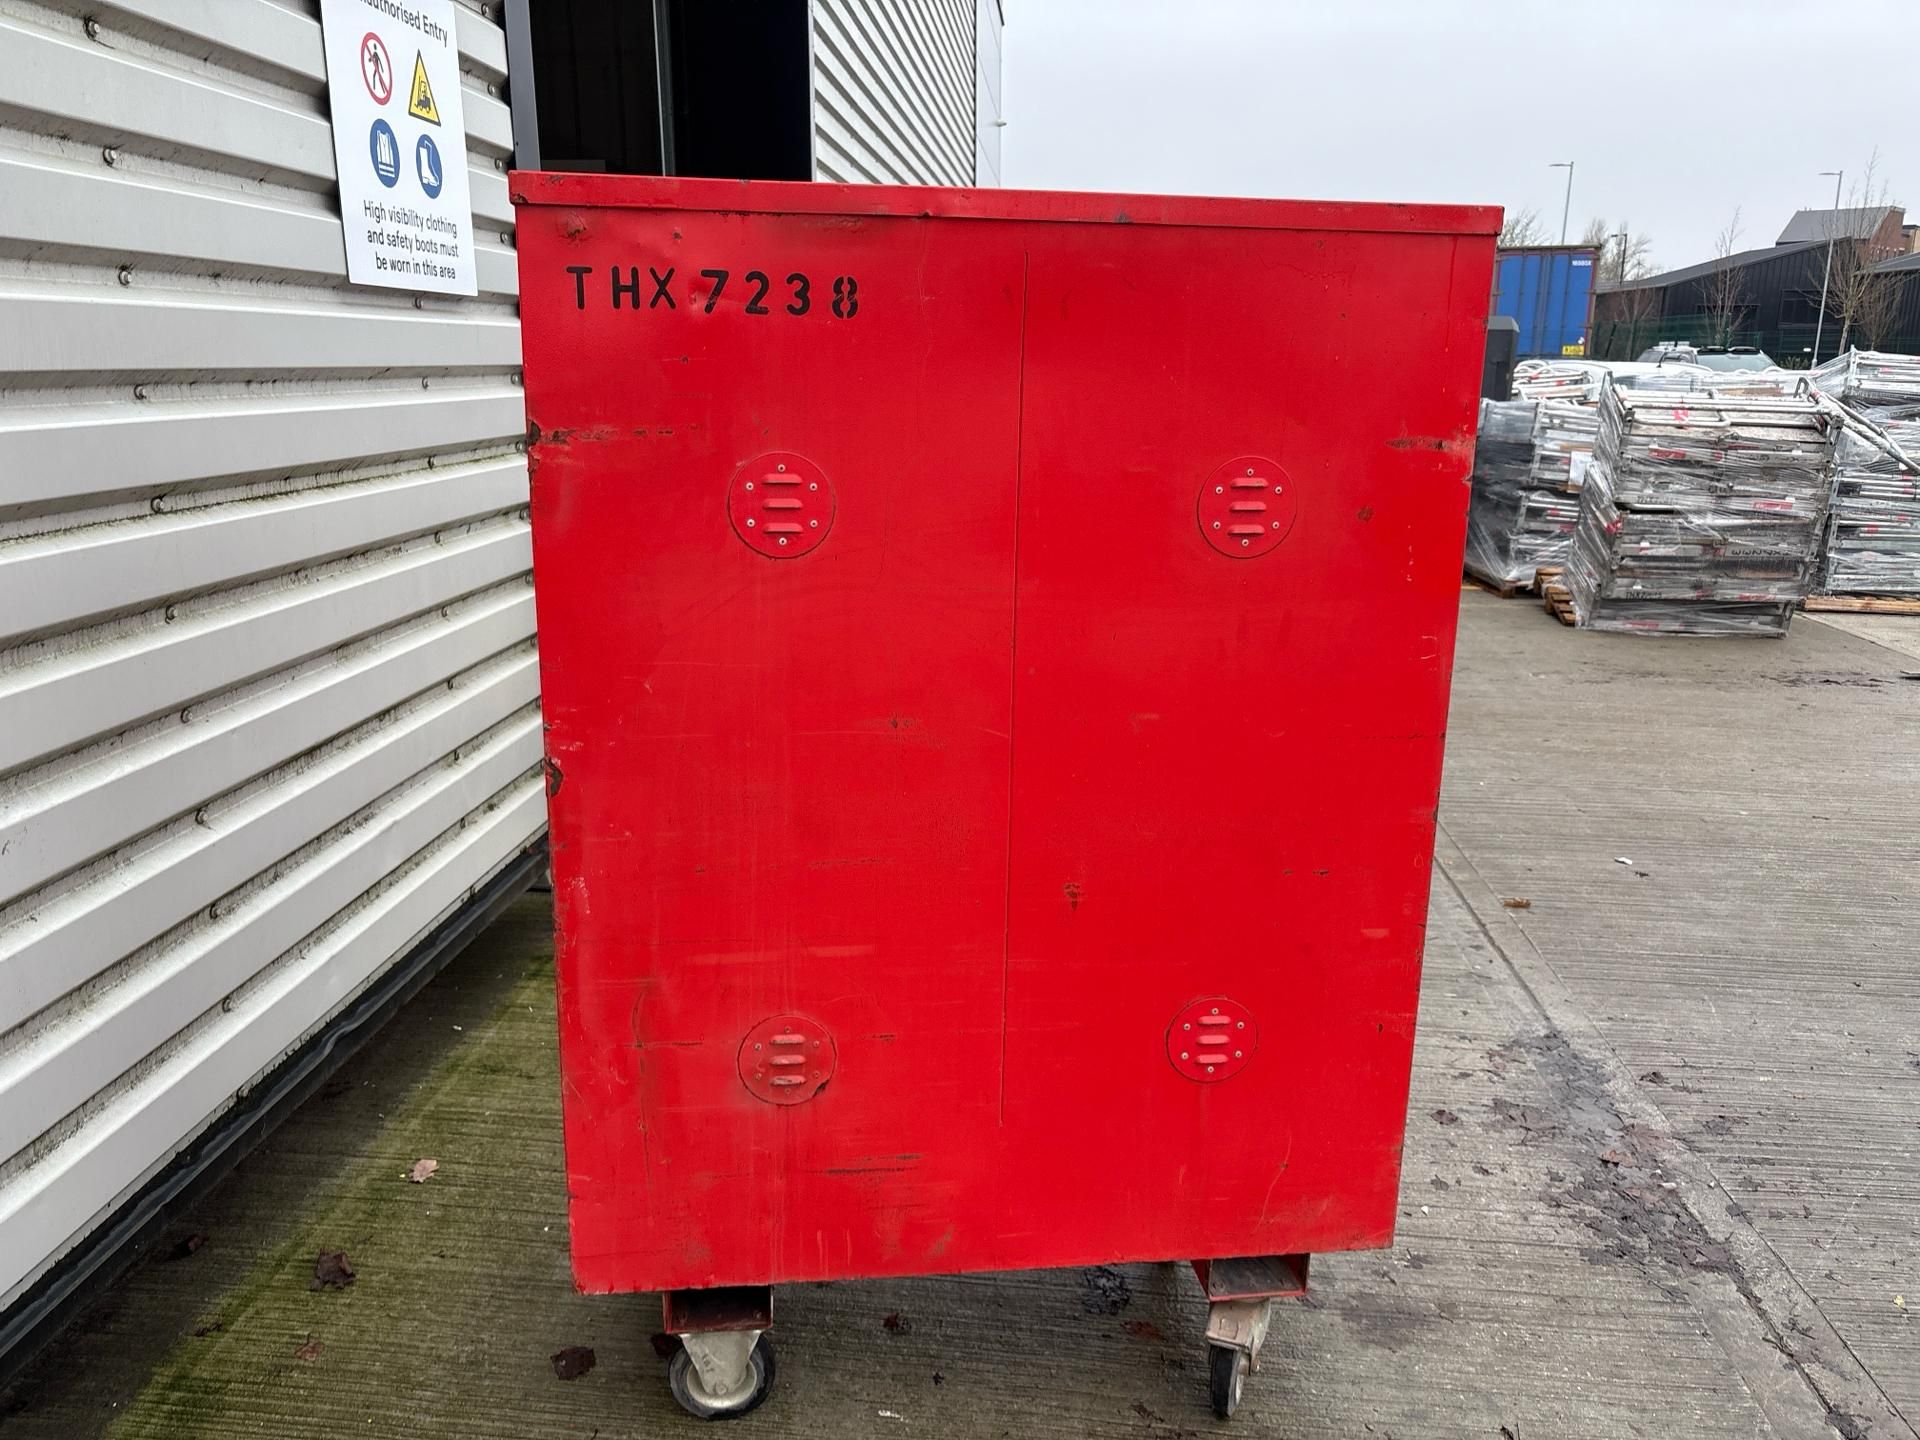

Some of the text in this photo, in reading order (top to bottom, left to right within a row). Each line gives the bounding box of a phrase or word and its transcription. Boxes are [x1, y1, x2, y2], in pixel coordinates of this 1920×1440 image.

[360, 0, 448, 48] authorised Entry
[363, 199, 457, 239] High visibility clothing
[367, 227, 459, 258] and safety boots must
[375, 251, 456, 279] be worn in this area
